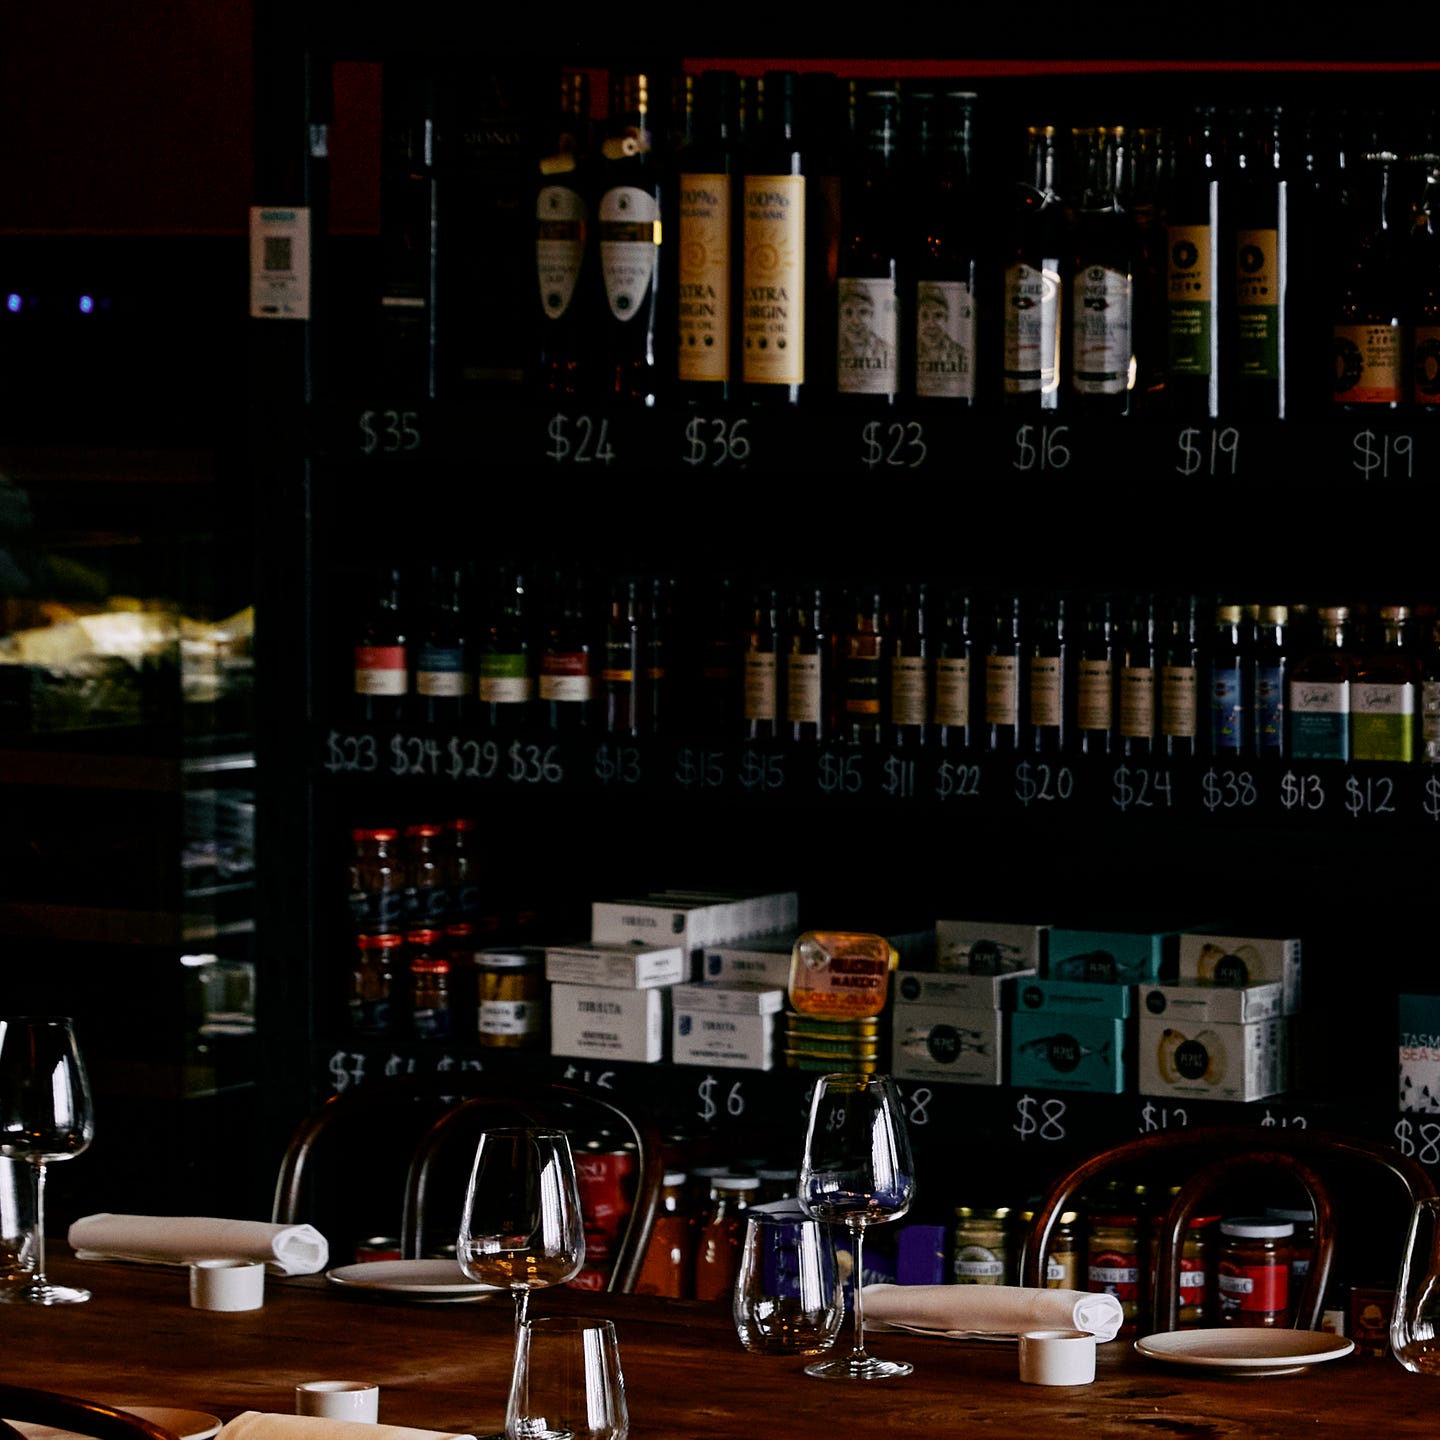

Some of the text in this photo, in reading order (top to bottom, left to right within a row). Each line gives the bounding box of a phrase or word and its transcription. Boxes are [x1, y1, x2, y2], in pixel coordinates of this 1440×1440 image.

[359, 409, 422, 455] $35
[545, 412, 616, 464] $24
[682, 414, 752, 468] $36
[861, 421, 928, 472] $23
[1012, 424, 1071, 472] $16
[1175, 426, 1240, 477] $19
[1352, 428, 1413, 481] $19
[323, 728, 378, 775] $23
[445, 735, 499, 780] $29
[507, 739, 564, 784] $36
[881, 753, 915, 798] $11
[935, 758, 982, 802] $22
[1015, 759, 1074, 807] $20
[1112, 763, 1173, 812] $24
[1201, 766, 1258, 812] $38
[1279, 768, 1325, 810] $13
[1344, 774, 1396, 818] $12
[1402, 1048, 1428, 1061] SEA
[695, 1074, 745, 1122] $6
[1013, 1094, 1067, 1141] $8
